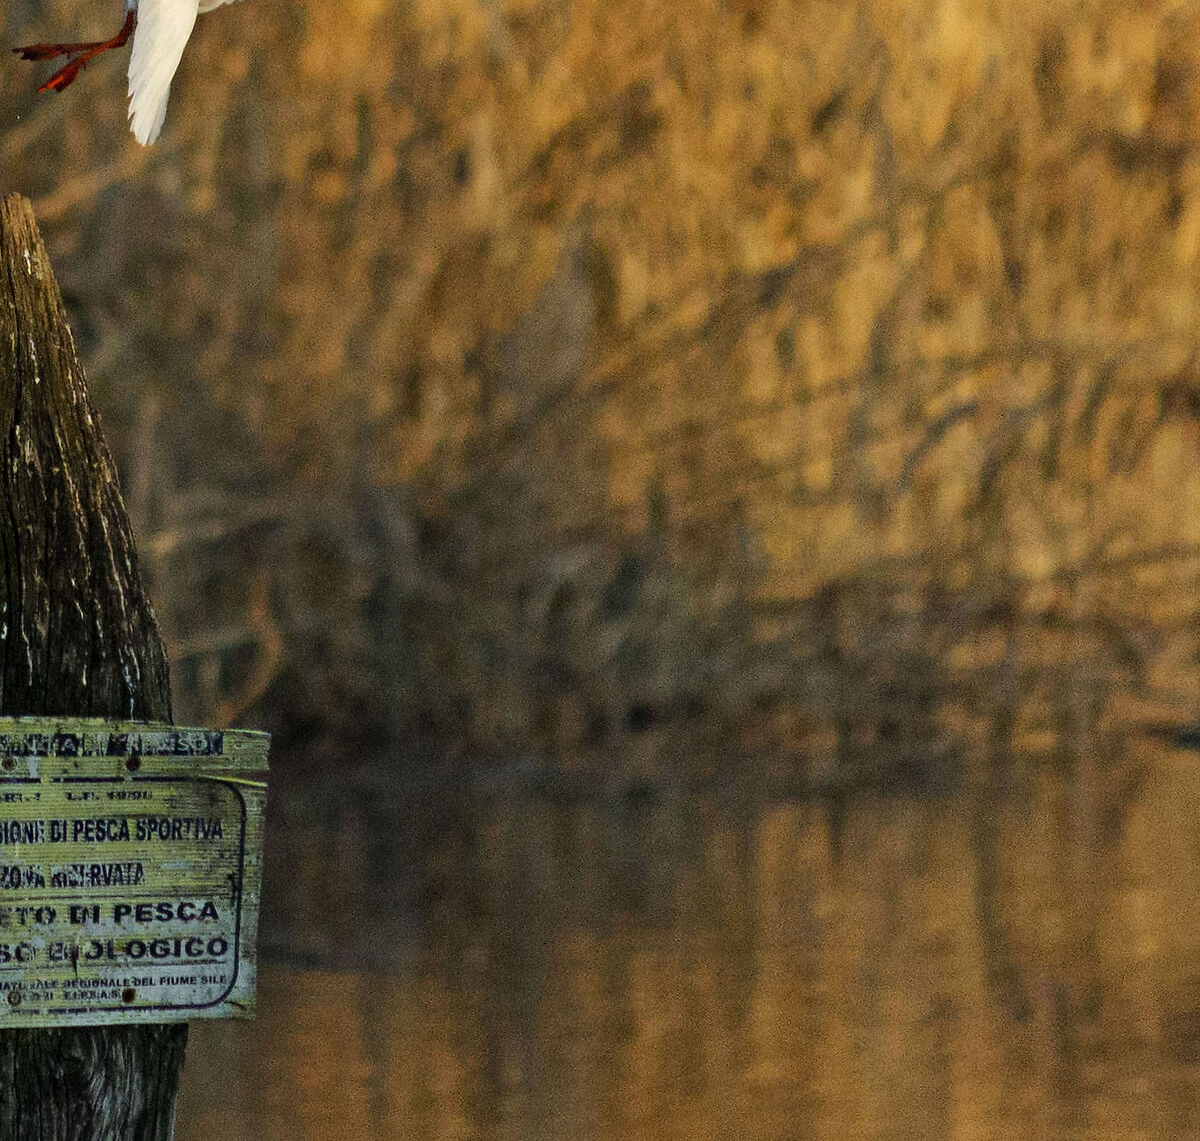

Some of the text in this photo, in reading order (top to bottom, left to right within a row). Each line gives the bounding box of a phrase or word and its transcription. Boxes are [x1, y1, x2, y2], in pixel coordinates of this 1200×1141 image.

[50, 819, 67, 843] DI
[73, 819, 130, 842] PESCA
[136, 816, 223, 841] SPORTIVA
[69, 904, 100, 924] DI
[114, 901, 219, 923] PESCA
[49, 937, 228, 961] BIOLOGICO
[63, 976, 131, 989] REGIONALE
[133, 975, 156, 986] DEL
[160, 975, 197, 986] FIUME
[201, 974, 227, 984] SILE
